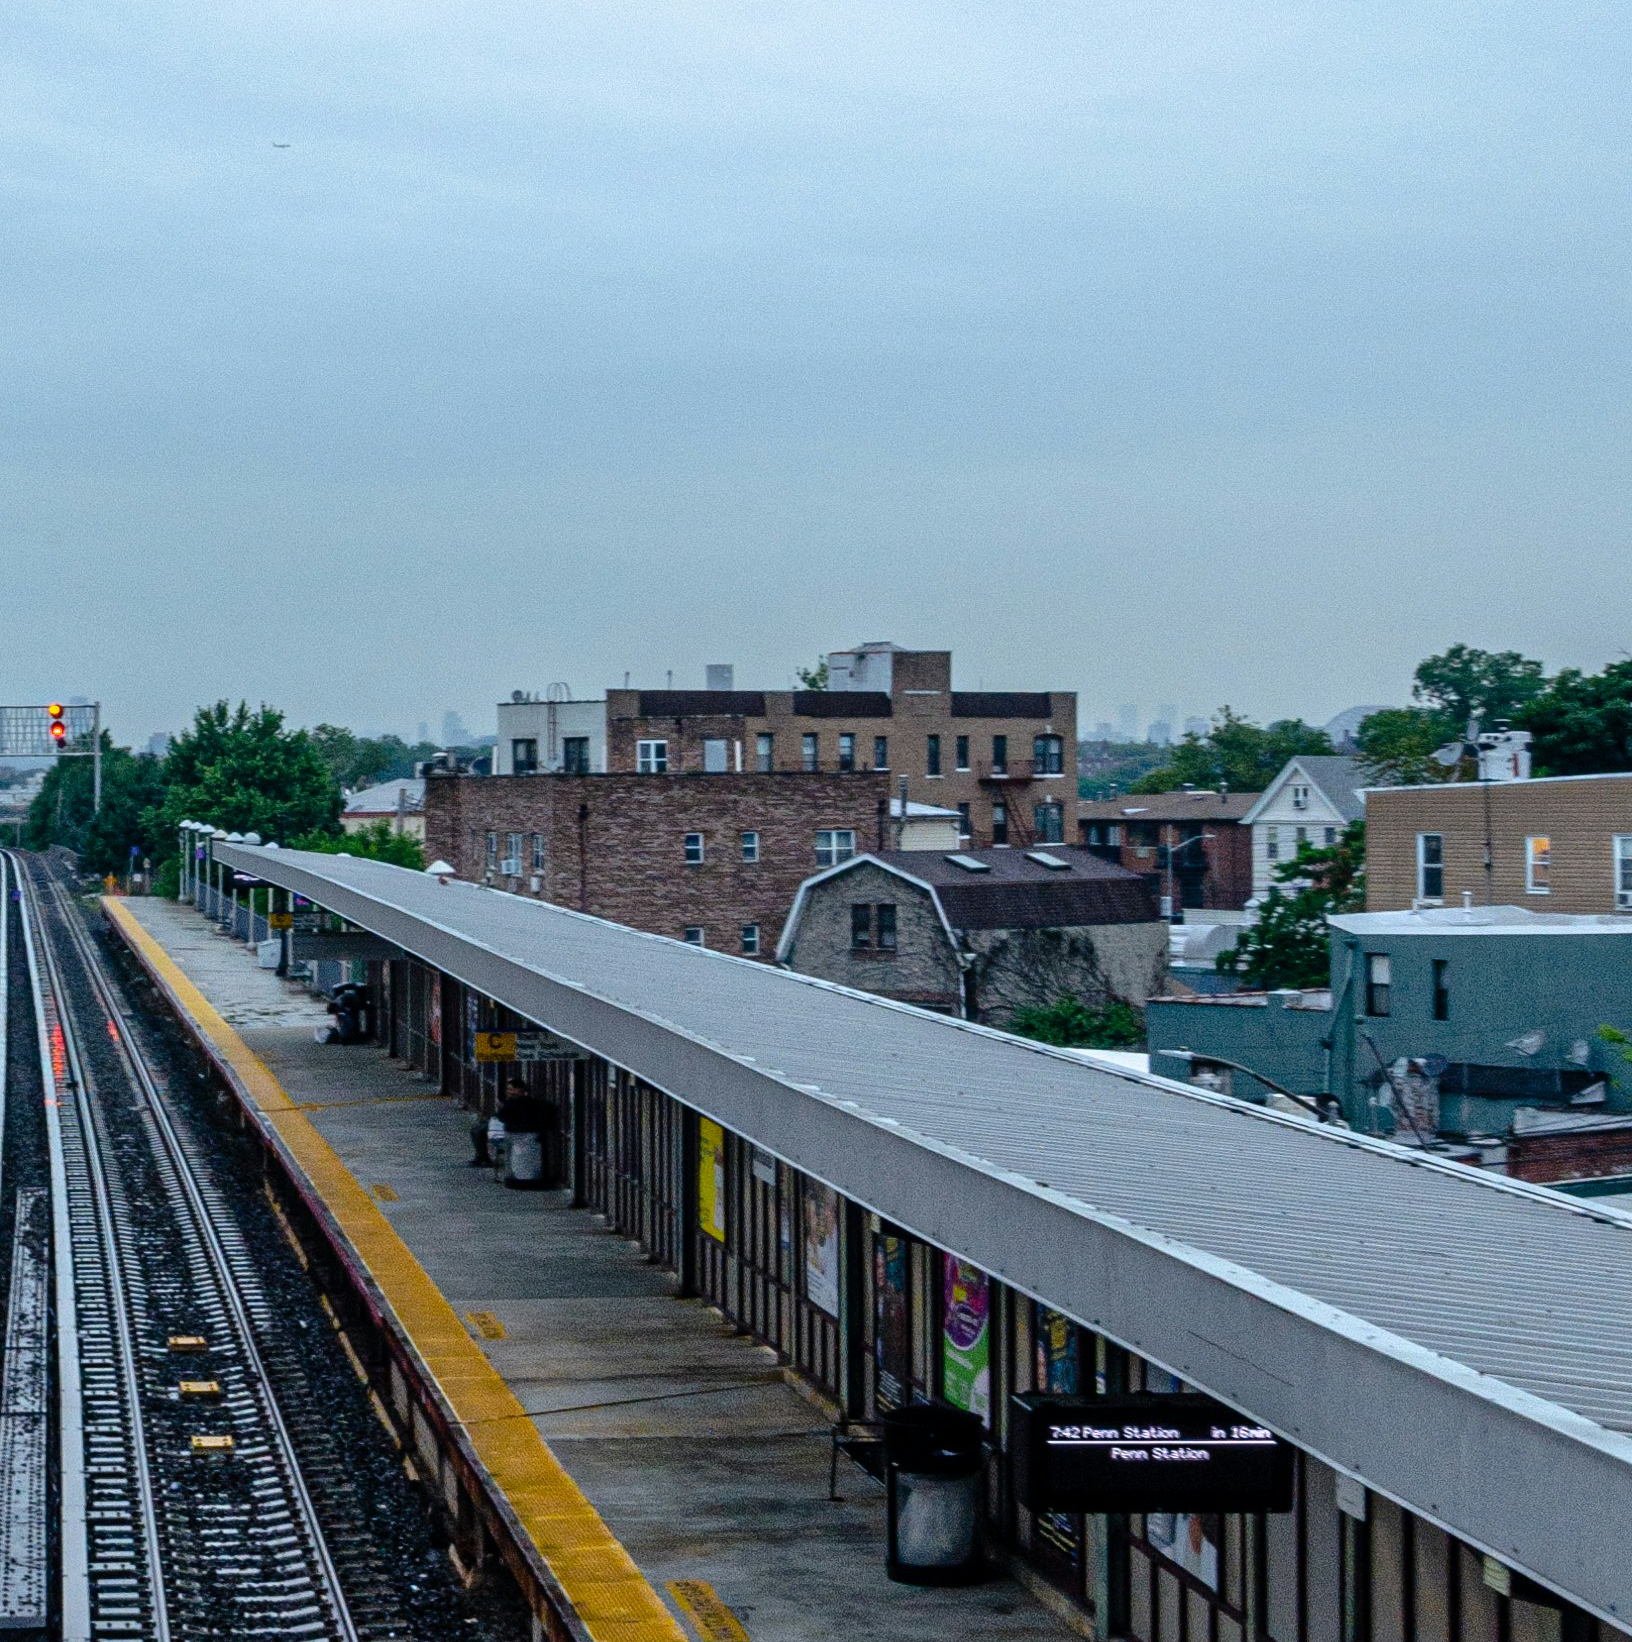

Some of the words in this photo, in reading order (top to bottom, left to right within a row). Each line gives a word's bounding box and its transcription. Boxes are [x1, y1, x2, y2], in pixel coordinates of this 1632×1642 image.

[1082, 1426, 1120, 1439] Penn
[1123, 1426, 1181, 1439] Station
[1111, 1446, 1149, 1460] Penn
[1151, 1446, 1210, 1460] Station
